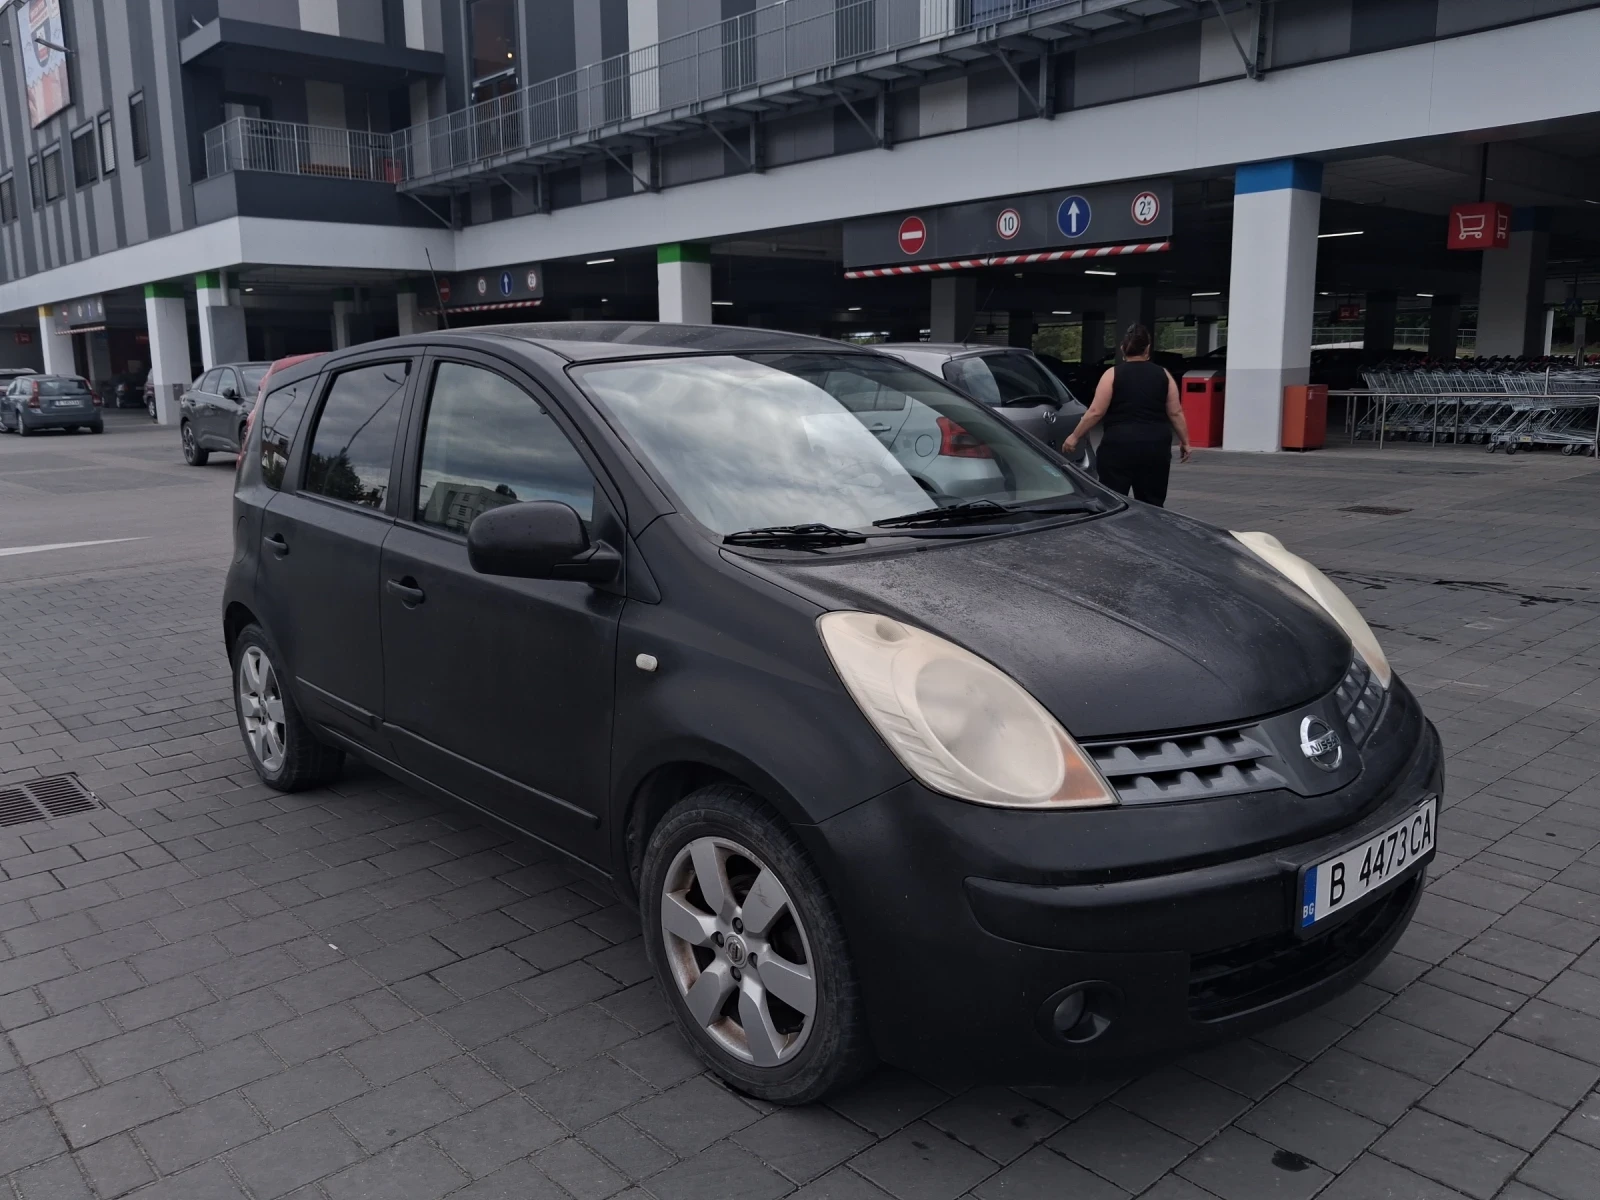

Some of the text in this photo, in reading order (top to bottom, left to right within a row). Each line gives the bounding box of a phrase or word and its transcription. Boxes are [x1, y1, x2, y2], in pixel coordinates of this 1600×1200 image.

[1003, 216, 1014, 232] 10
[1329, 861, 1346, 908] B
[1303, 902, 1315, 919] BG
